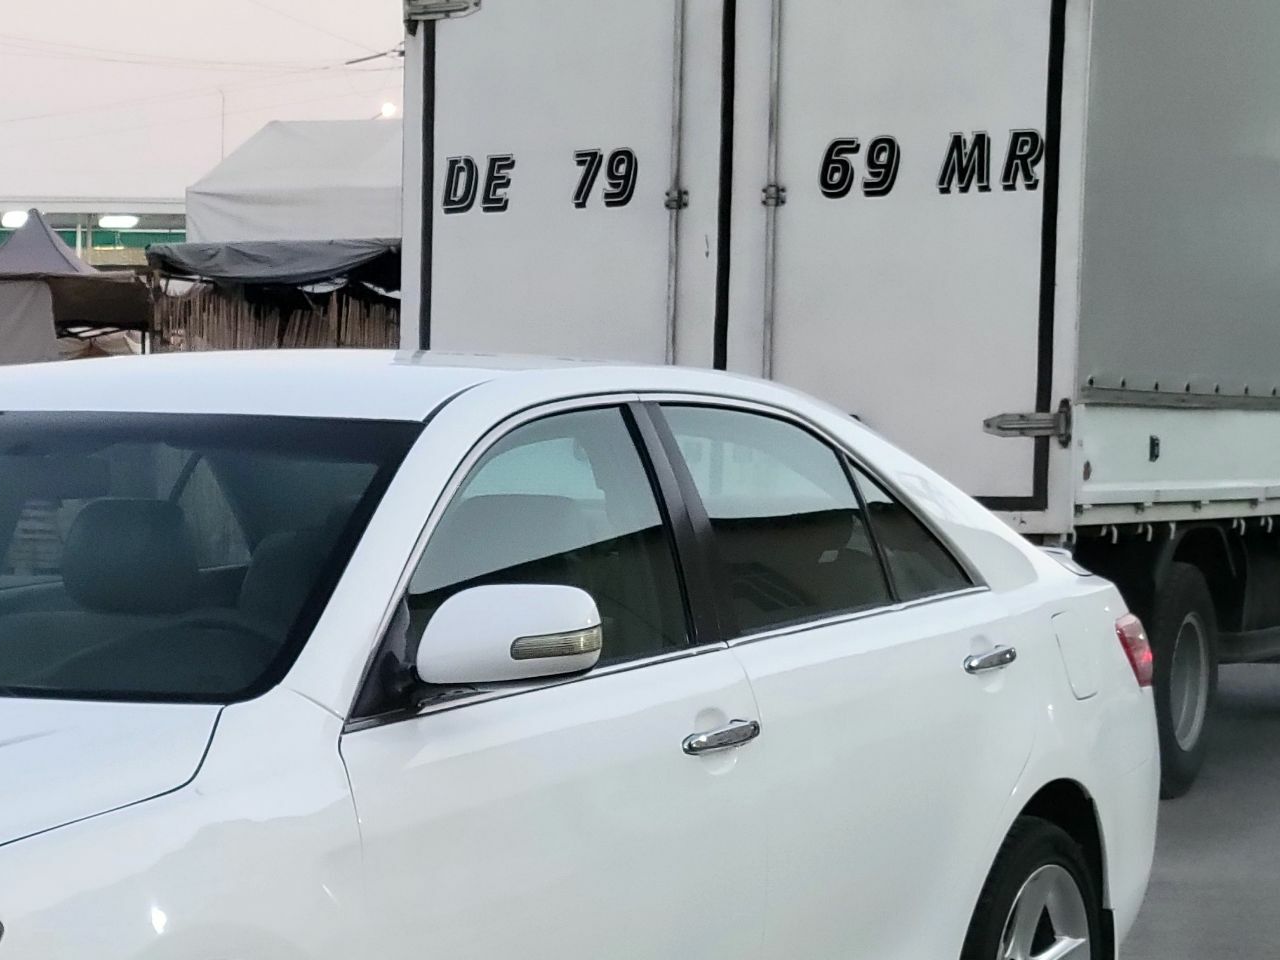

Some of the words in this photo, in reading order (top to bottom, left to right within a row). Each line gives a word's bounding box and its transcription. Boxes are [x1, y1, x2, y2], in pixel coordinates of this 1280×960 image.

[442, 153, 516, 214] DE
[571, 147, 638, 209] 79
[818, 134, 901, 199] 69
[936, 128, 1045, 194] MR
